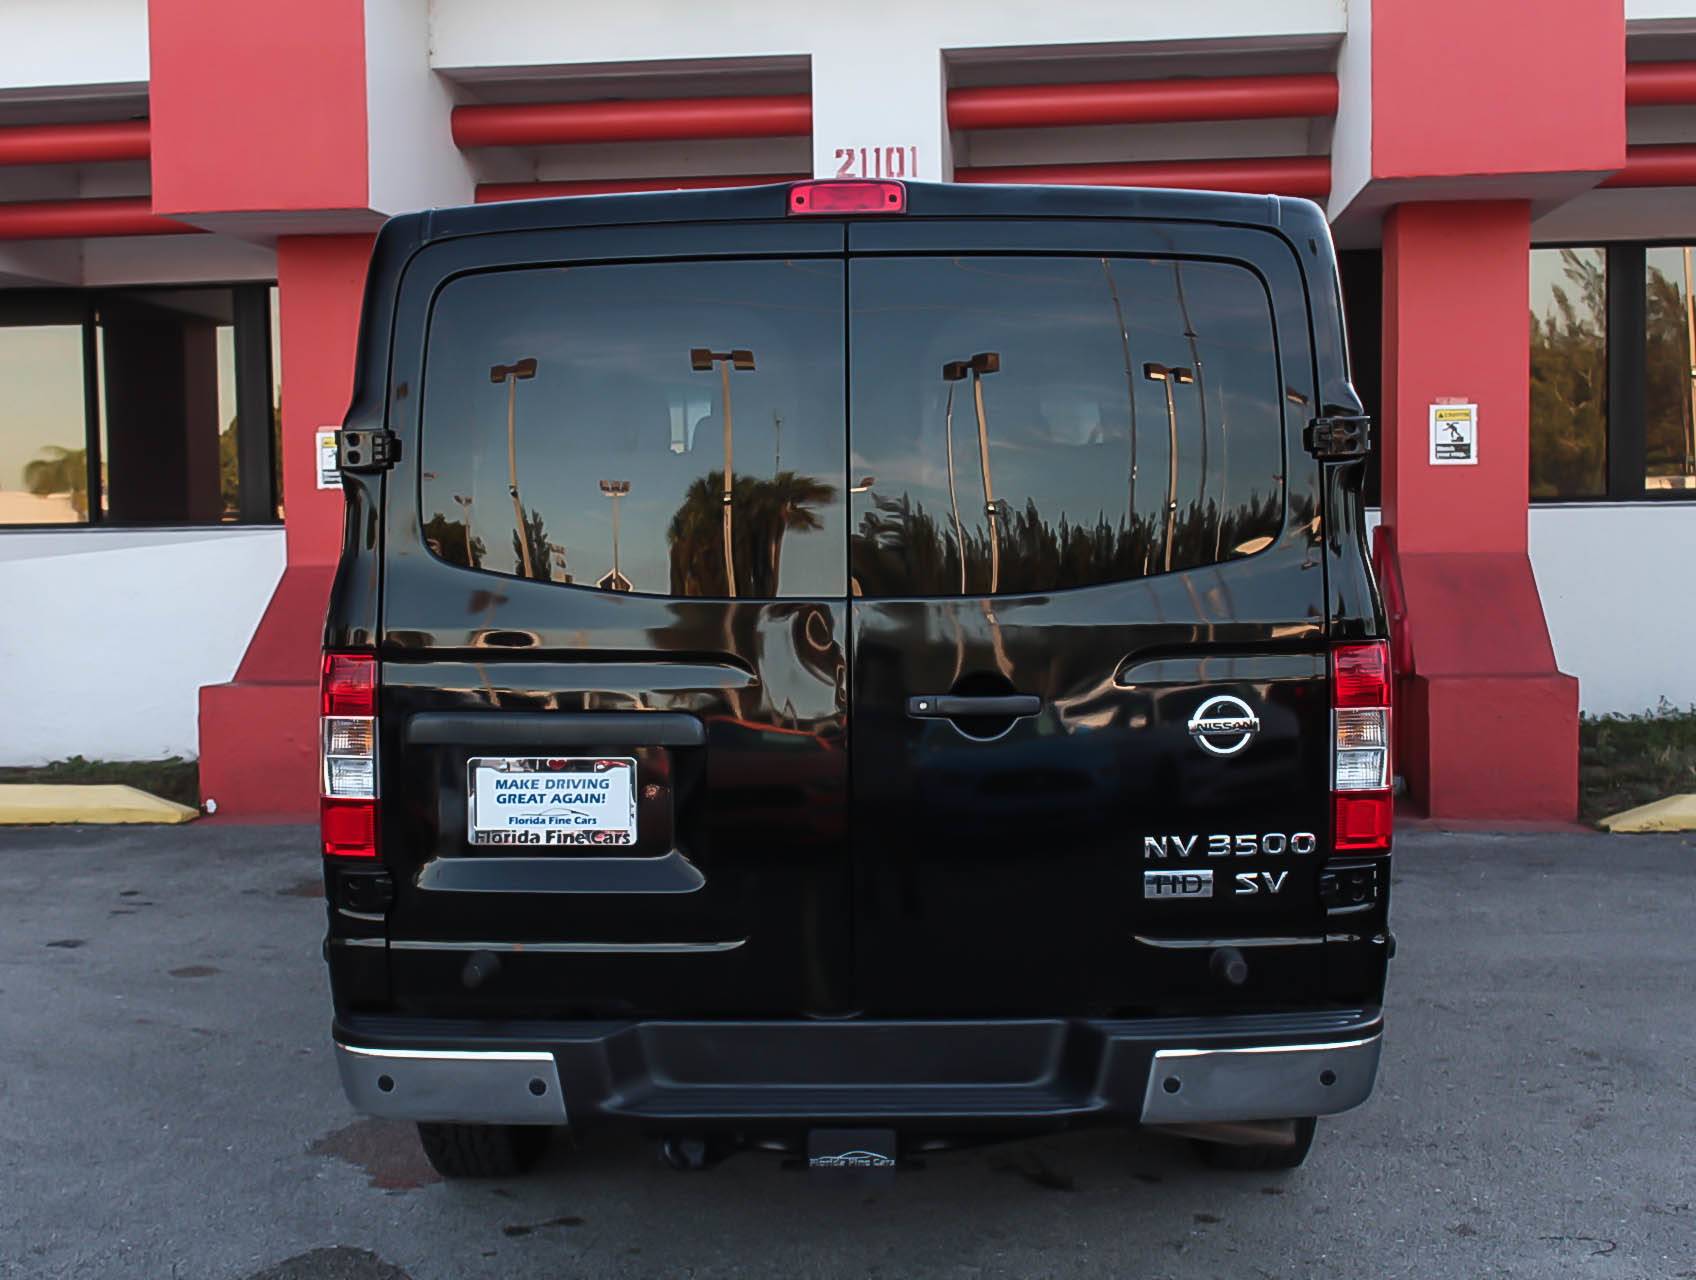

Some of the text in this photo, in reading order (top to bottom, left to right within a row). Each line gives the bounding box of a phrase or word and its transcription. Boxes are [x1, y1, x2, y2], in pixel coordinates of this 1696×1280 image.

[835, 146, 918, 178] 21101
[1196, 720, 1253, 731] NISSAN
[495, 778, 610, 790] MAKE DRIVING
[496, 793, 606, 804] GREAT AGAIN!
[508, 816, 597, 825] Florida Fine Cars
[475, 830, 631, 844] Florida Fine Cars
[1144, 832, 1316, 858] NV 3500
[1156, 871, 1289, 895] HD SV
